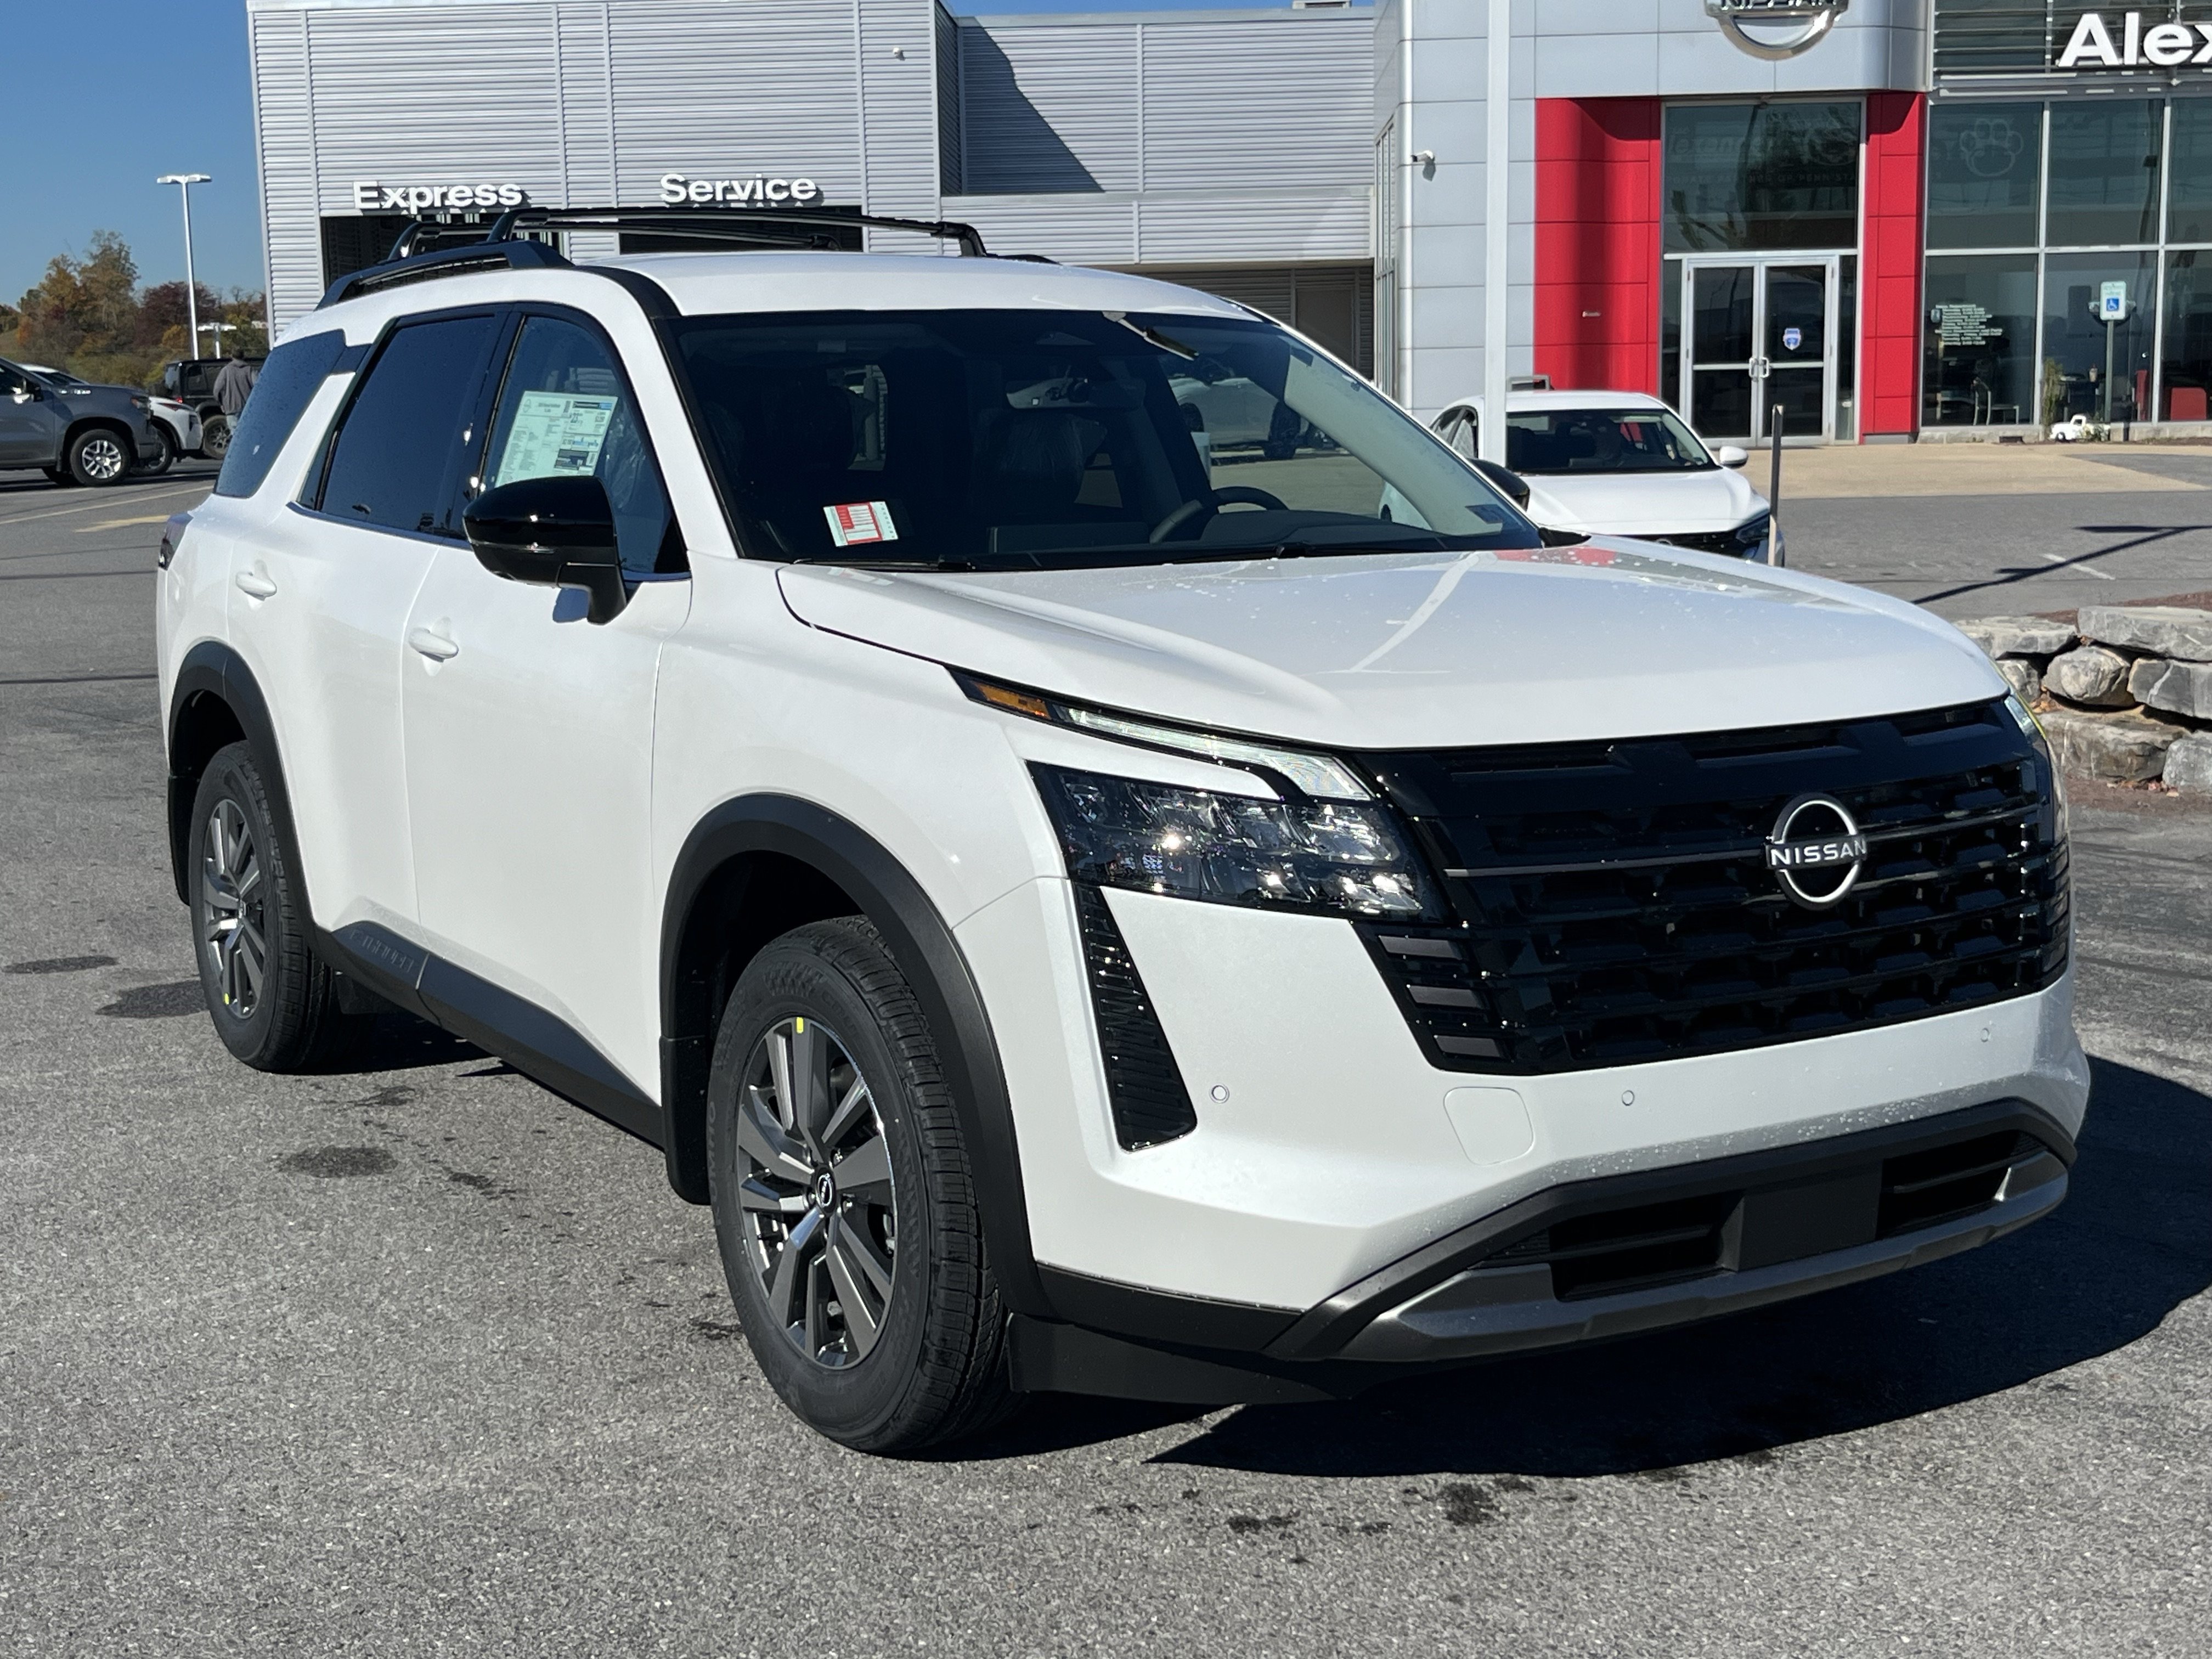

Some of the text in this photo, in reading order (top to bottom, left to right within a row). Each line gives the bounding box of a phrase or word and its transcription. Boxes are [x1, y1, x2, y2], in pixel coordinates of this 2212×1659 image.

[353, 180, 522, 215] Express
[659, 173, 817, 202] Service
[1770, 838, 1866, 866] NISSAN
